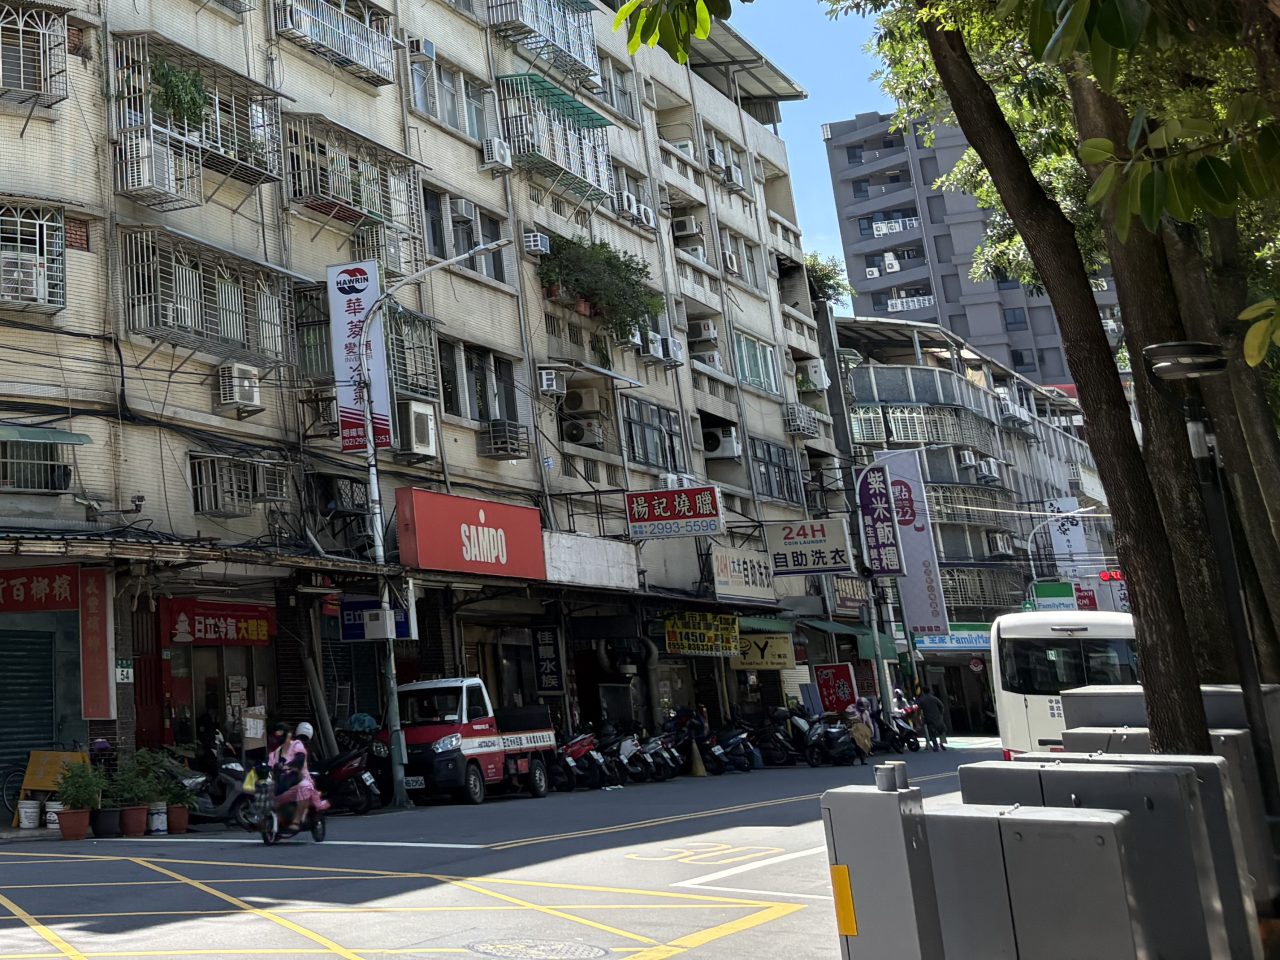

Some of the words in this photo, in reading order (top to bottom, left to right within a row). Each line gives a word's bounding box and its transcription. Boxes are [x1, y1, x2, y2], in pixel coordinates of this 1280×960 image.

[336, 277, 369, 287] HAWRIN
[631, 490, 717, 520] 楊記燒臘
[648, 520, 718, 535] 2993-5596
[867, 470, 900, 570] 紫米飯糰
[782, 523, 826, 541] 24H
[461, 523, 507, 565] SAMPO
[773, 547, 848, 569] 自助洗衣
[1037, 602, 1075, 610] FamilyMart
[950, 634, 991, 645] FamilyMa
[120, 669, 130, 681] 54
